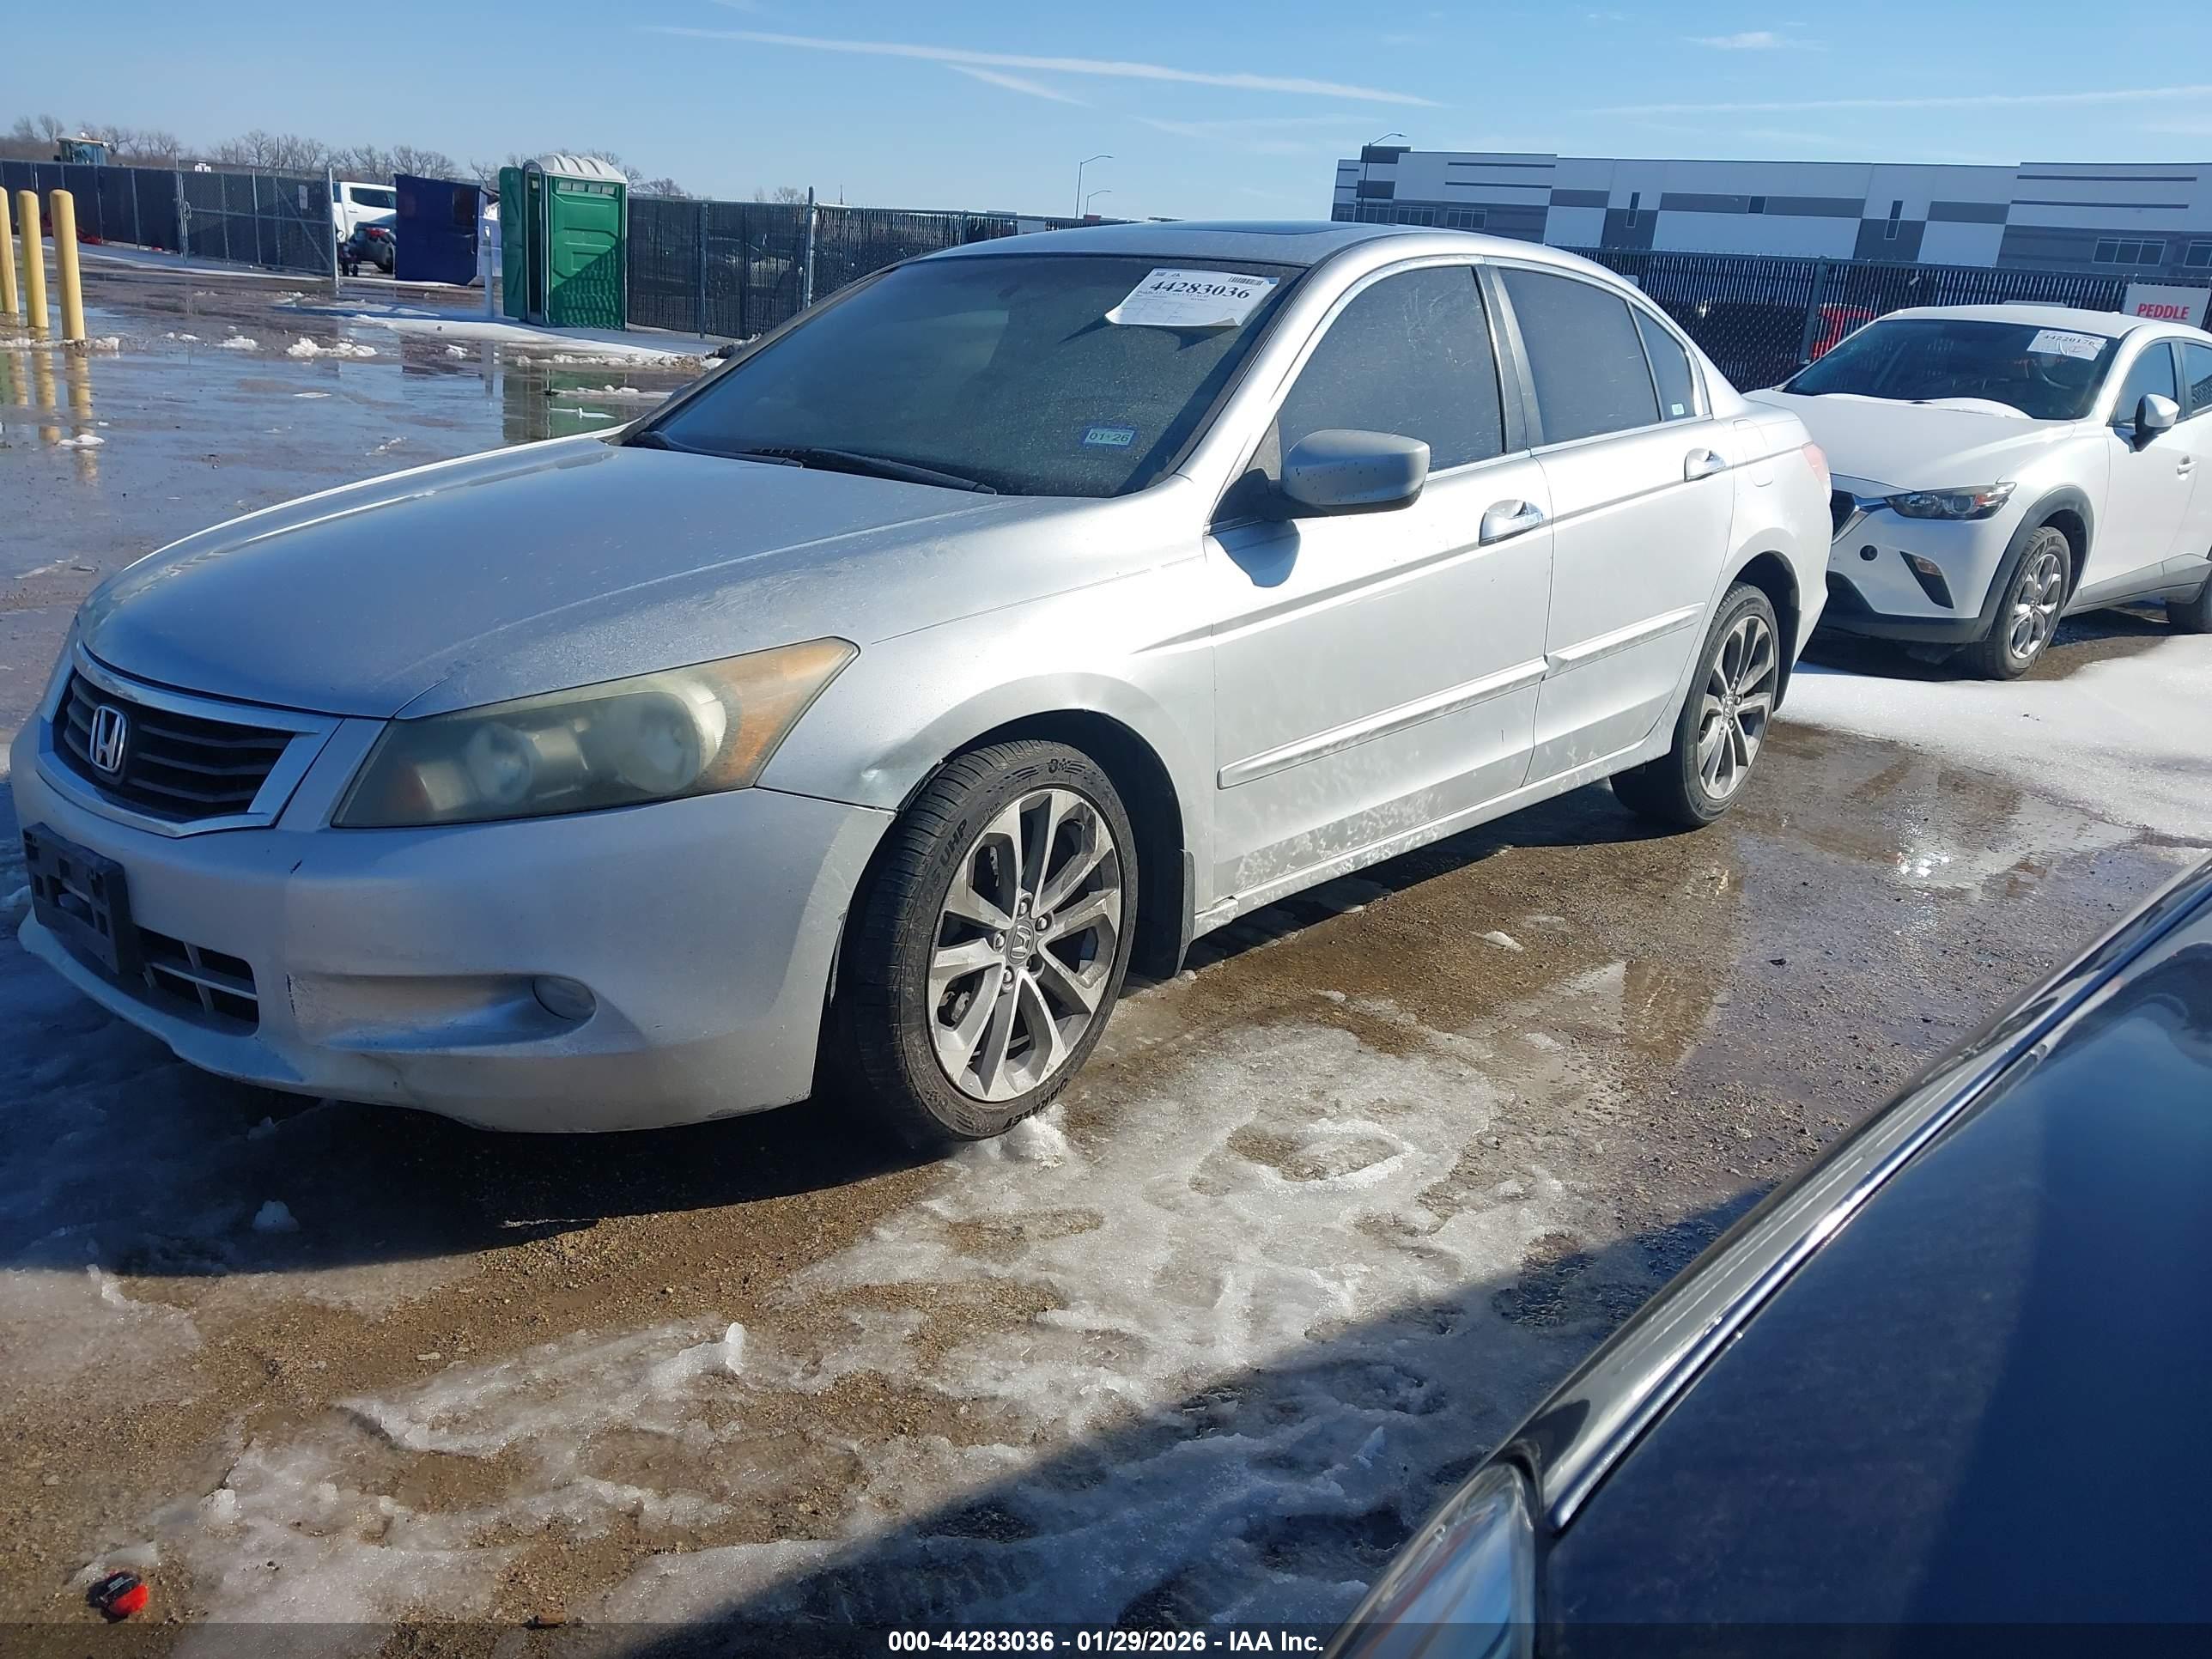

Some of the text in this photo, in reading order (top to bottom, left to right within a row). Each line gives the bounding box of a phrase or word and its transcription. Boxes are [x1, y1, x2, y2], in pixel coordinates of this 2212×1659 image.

[1150, 281, 1255, 300] 44283036
[2136, 303, 2191, 319] PEDDLE
[1089, 432, 1130, 442] 01 26
[939, 818, 967, 866] UHP
